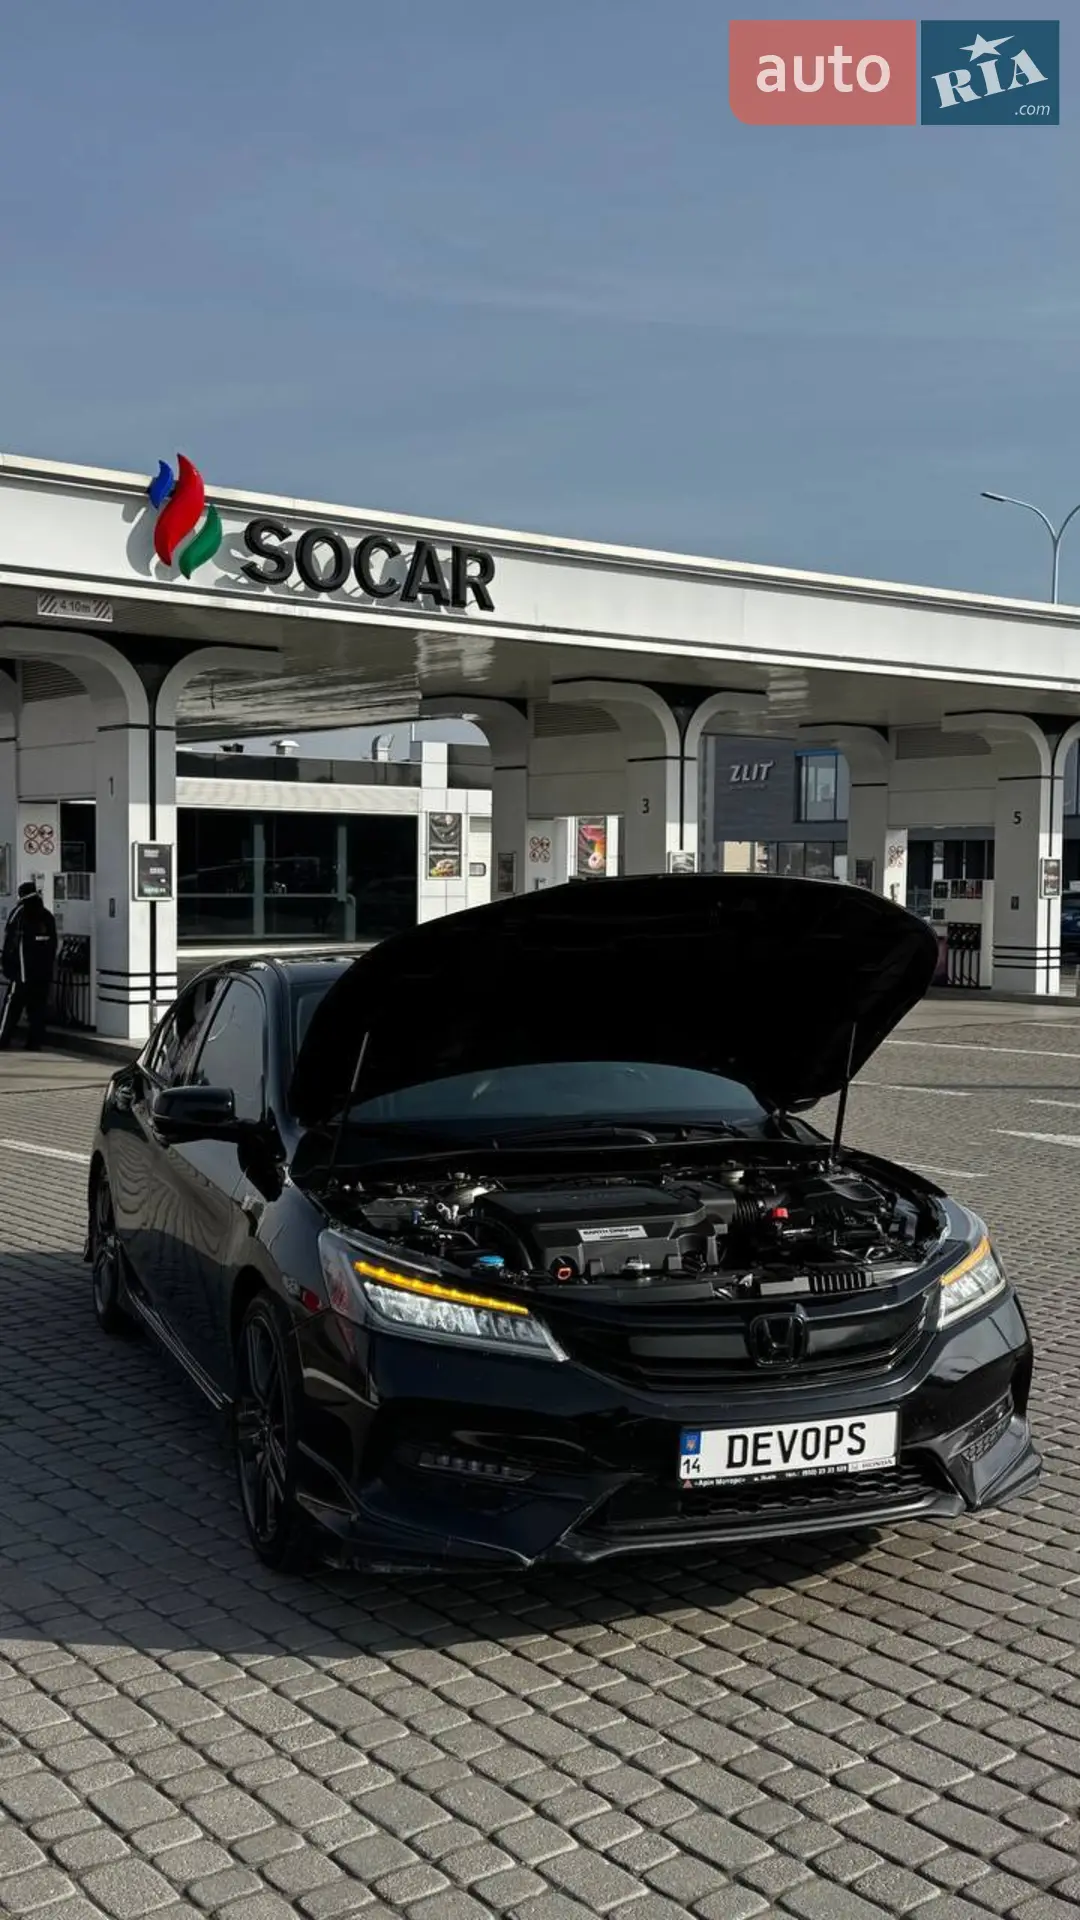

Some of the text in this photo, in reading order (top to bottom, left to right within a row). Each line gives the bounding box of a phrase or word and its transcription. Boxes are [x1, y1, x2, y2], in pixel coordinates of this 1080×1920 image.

[240, 518, 496, 613] SOCAR
[730, 760, 774, 782] ZLIT
[108, 776, 115, 798] 1
[642, 798, 650, 814] 3
[1013, 811, 1023, 825] 5
[726, 1422, 866, 1469] DEVOPS
[683, 1457, 701, 1474] 14
